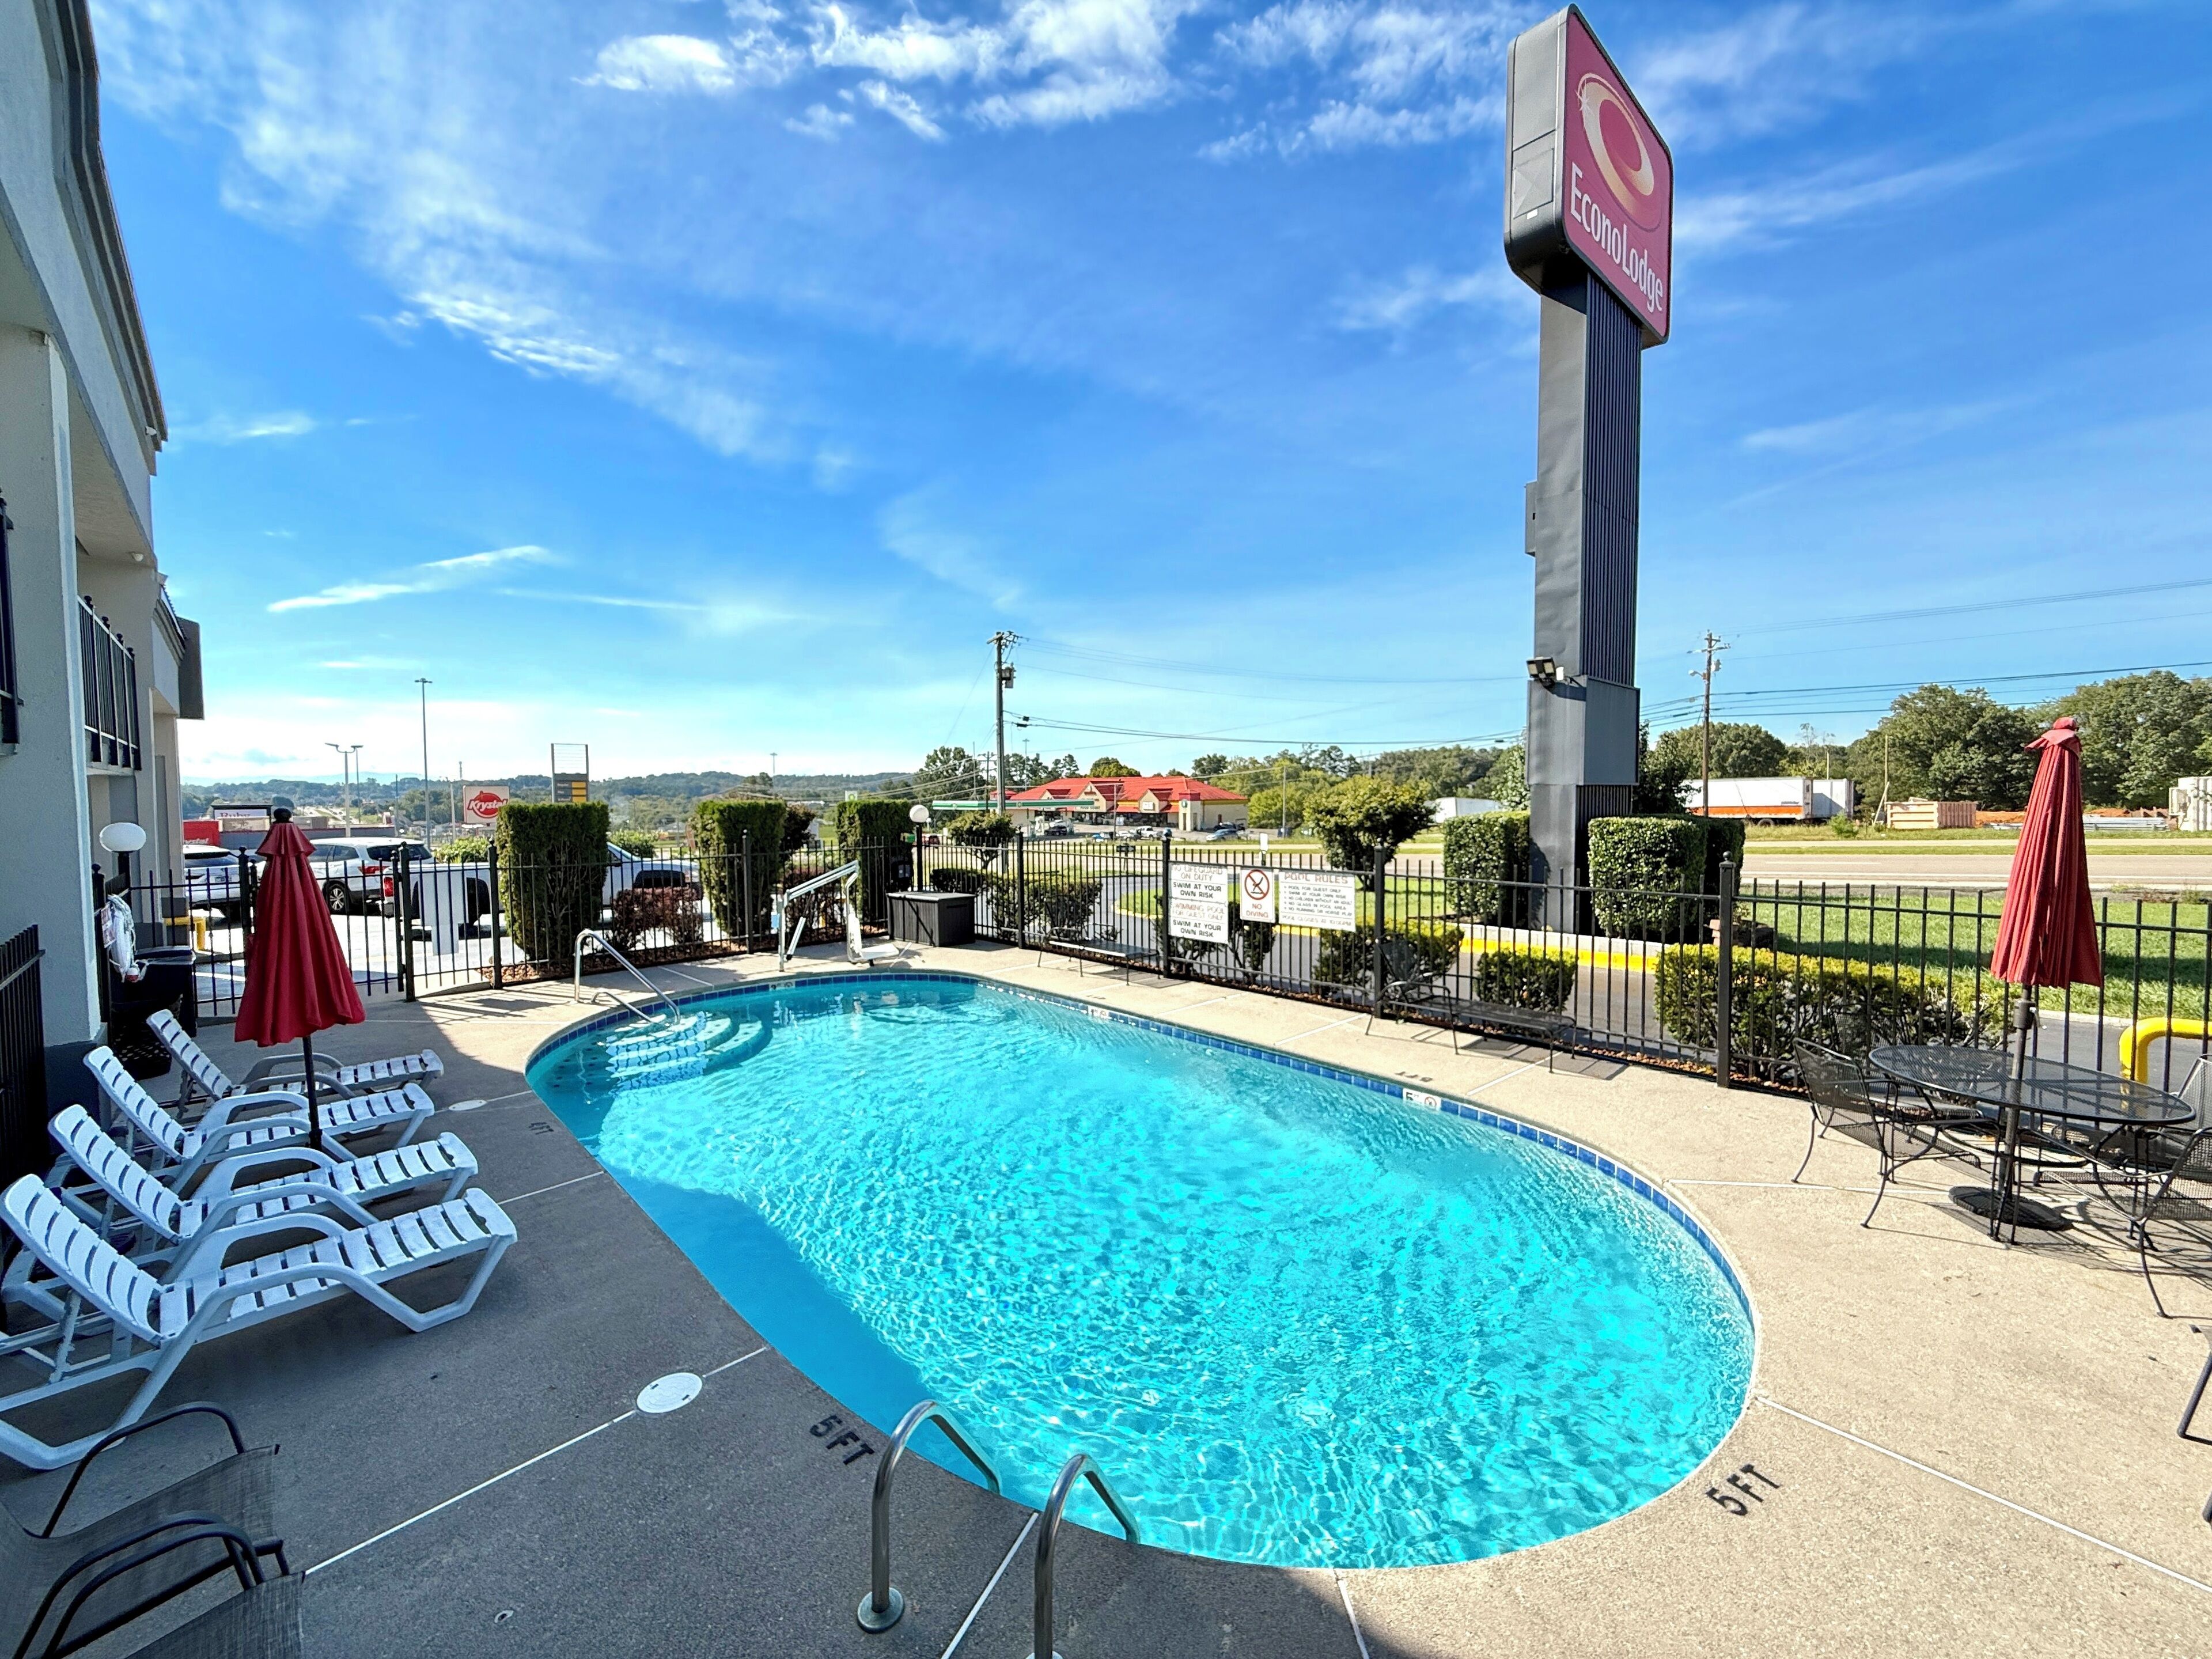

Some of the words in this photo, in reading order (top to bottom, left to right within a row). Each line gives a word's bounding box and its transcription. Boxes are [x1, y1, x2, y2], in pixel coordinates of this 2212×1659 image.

[1570, 162, 1662, 313] EconoLodge
[1184, 865, 1223, 875] LIFEGUARD
[1284, 872, 1310, 881] POOL
[1315, 874, 1348, 884] RULES
[1173, 903, 1205, 911] WIMMING
[1207, 906, 1225, 914] POOL
[1180, 927, 1196, 935] OWN
[809, 1415, 875, 1465] 5FT
[1705, 1464, 1782, 1516] 5FT
